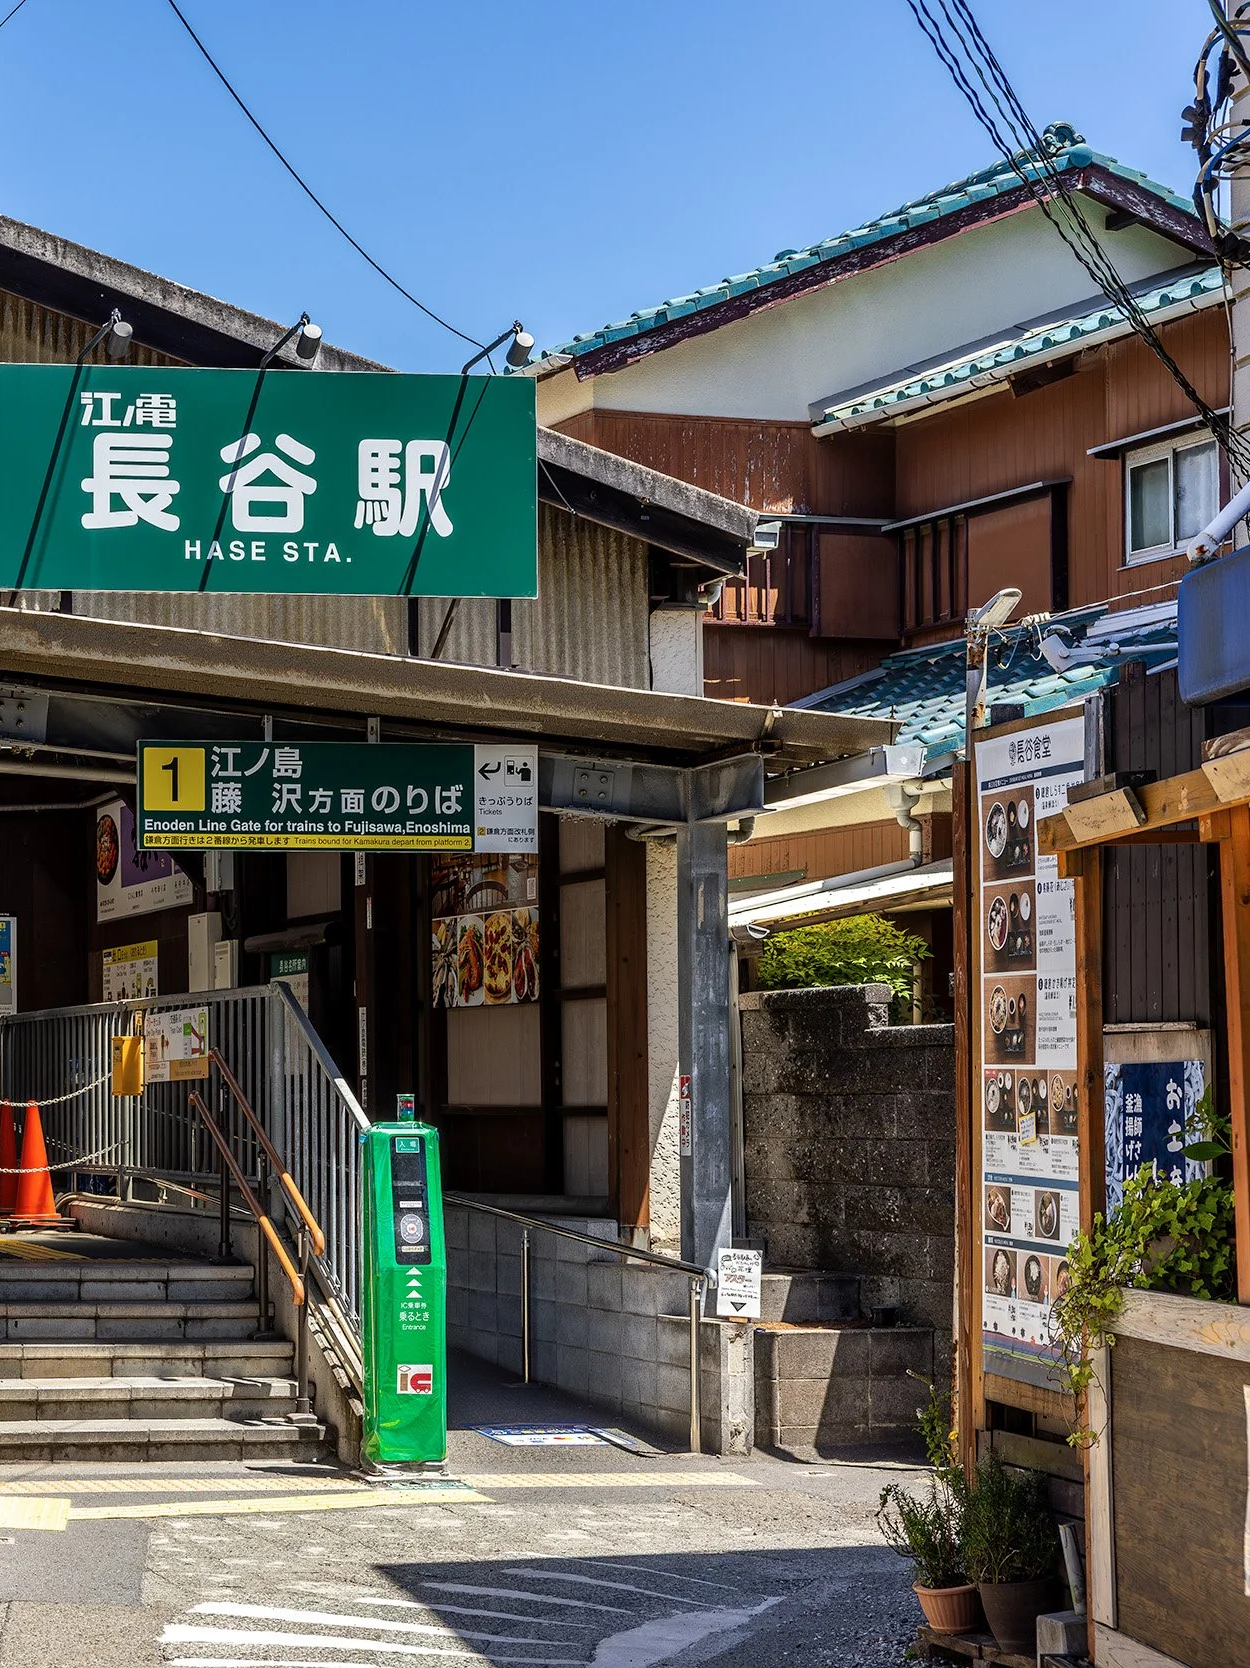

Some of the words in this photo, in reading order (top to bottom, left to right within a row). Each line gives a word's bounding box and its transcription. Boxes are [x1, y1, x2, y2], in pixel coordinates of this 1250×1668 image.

[80, 432, 454, 538] 長谷駅
[184, 540, 266, 561] HASE
[283, 541, 352, 563] STA.
[1017, 734, 1052, 763] 長谷食堂
[211, 746, 303, 779] 江ノ島
[161, 756, 179, 803] 1
[478, 796, 533, 806] きっぷうりば
[144, 819, 194, 831] Enoden
[198, 819, 227, 831] Line
[230, 820, 261, 832] Gate
[264, 820, 283, 832] for
[286, 820, 324, 832] trains
[327, 821, 341, 832] to
[353, 838, 390, 846] Kamakura
[391, 838, 415, 847] depart
[416, 838, 432, 846] from
[434, 838, 463, 847] platform
[399, 1311, 430, 1321] 乗るとき
